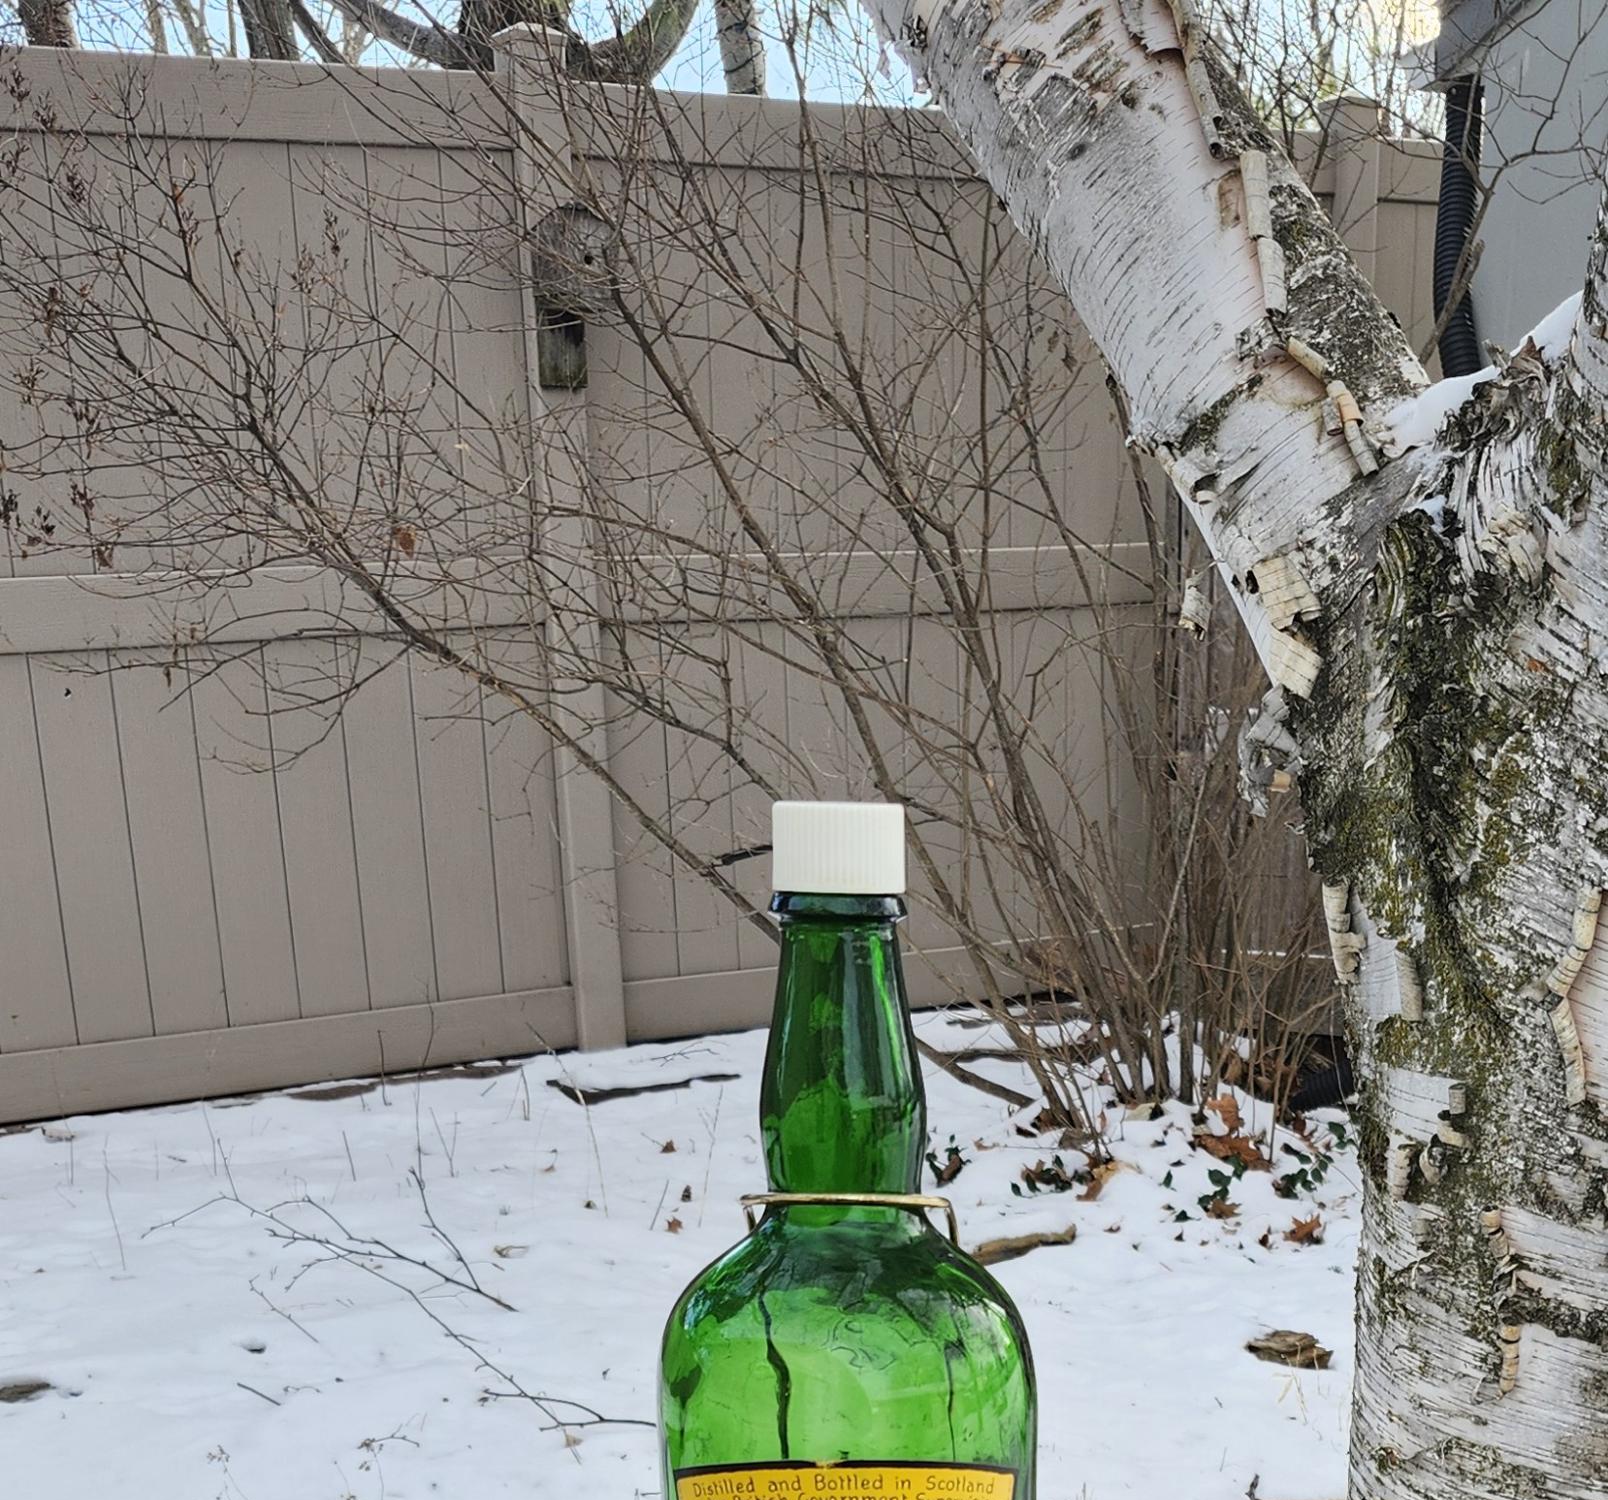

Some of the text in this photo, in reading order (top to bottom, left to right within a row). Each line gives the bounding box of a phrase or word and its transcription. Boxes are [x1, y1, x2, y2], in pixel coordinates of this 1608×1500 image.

[692, 1473, 995, 1497] Distilled and Bottled in Scotland
